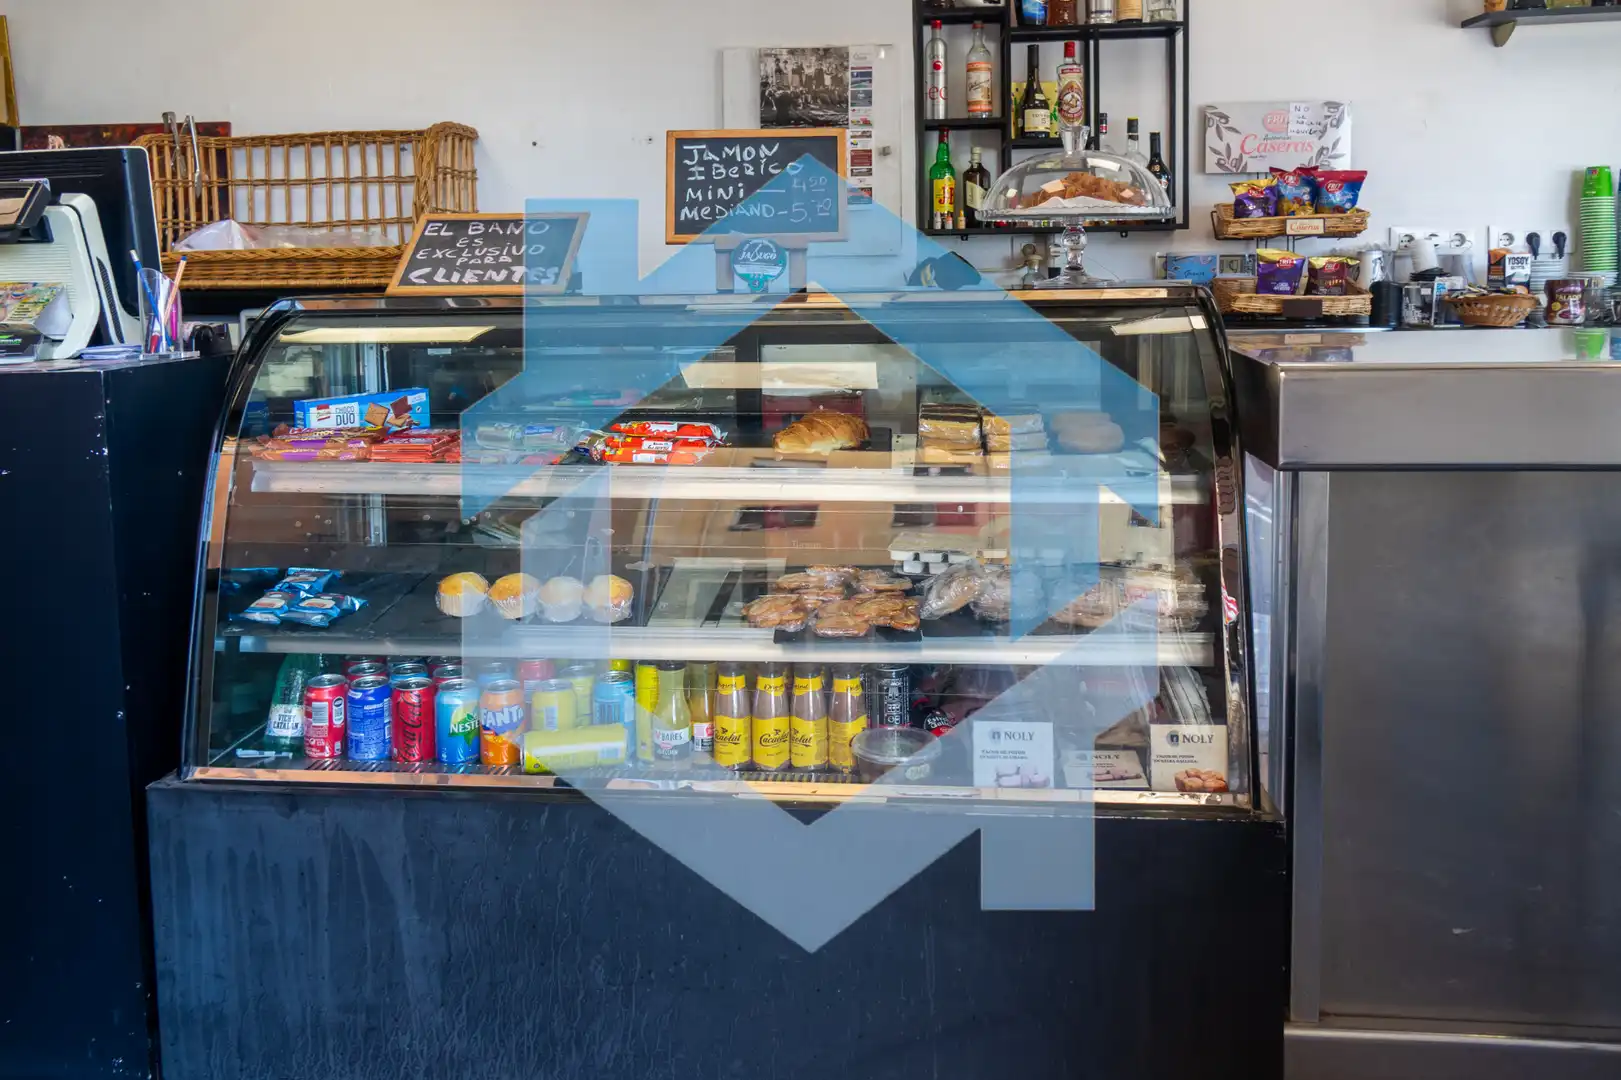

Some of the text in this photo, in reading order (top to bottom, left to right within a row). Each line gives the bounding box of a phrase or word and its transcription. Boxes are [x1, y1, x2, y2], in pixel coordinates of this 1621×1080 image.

[1241, 133, 1313, 155] Caseras
[683, 143, 780, 165] JAMON
[424, 222, 453, 236] EL
[456, 237, 484, 248] ES
[456, 256, 513, 266] PARA
[1507, 256, 1529, 265] YOSOY
[335, 405, 355, 414] CHOCO
[335, 413, 356, 426] DUO
[449, 719, 480, 734] NESTE
[1004, 731, 1035, 741] NOLY
[1182, 734, 1214, 744] NOLY
